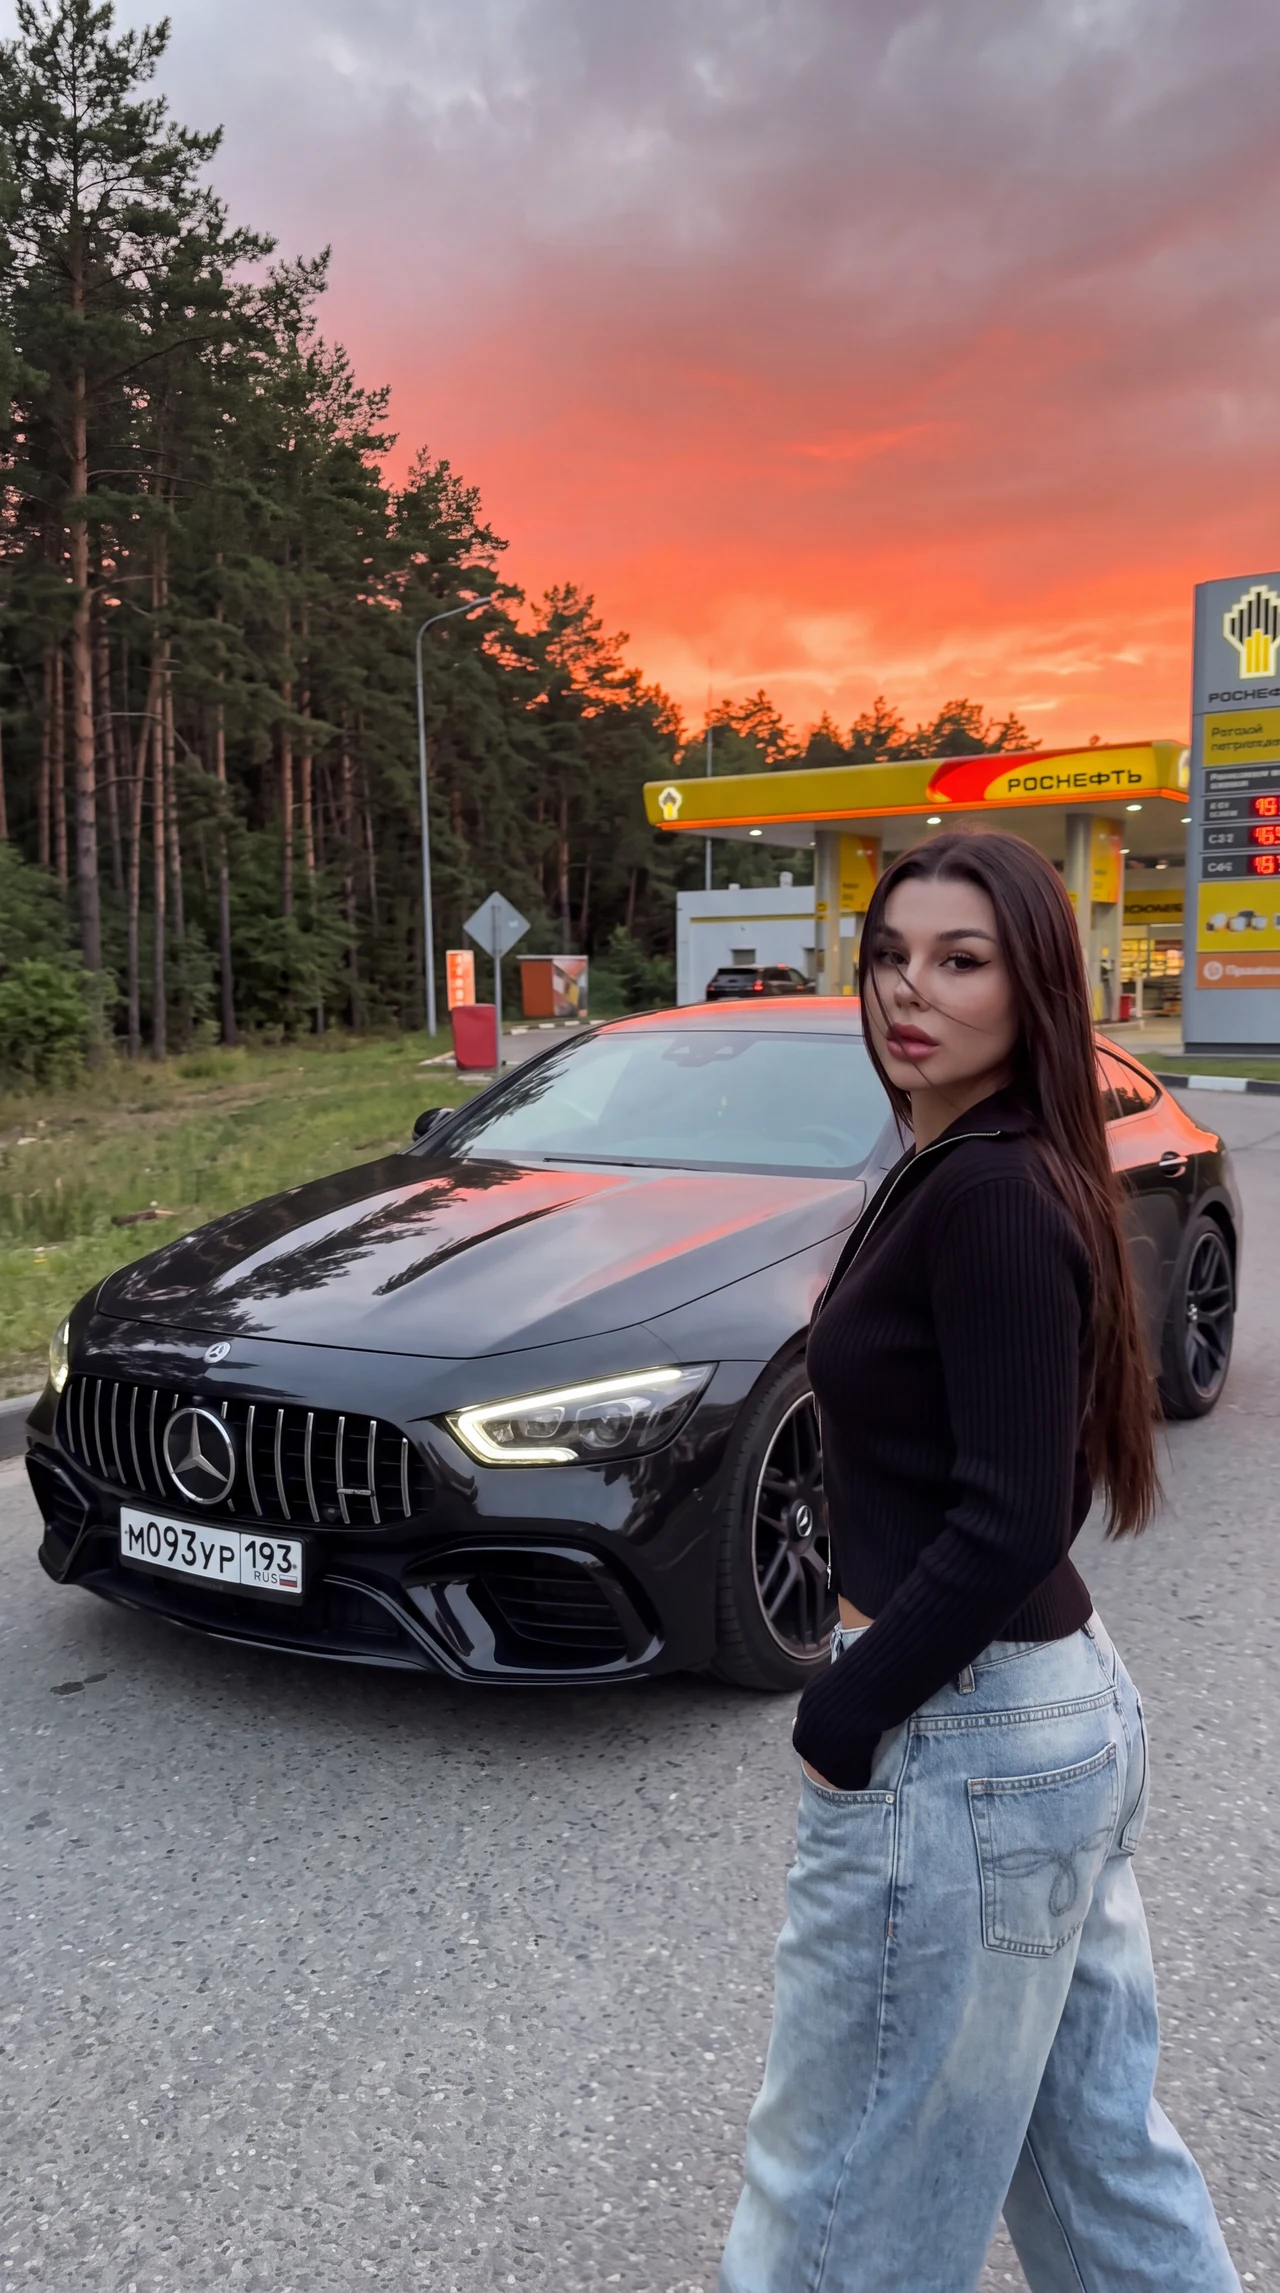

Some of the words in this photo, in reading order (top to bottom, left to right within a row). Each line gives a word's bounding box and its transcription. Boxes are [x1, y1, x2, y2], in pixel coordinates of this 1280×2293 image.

[1007, 769, 1142, 793] РОСНЕФТЬ
[244, 1540, 292, 1574] 193
[253, 1570, 278, 1585] RUS
